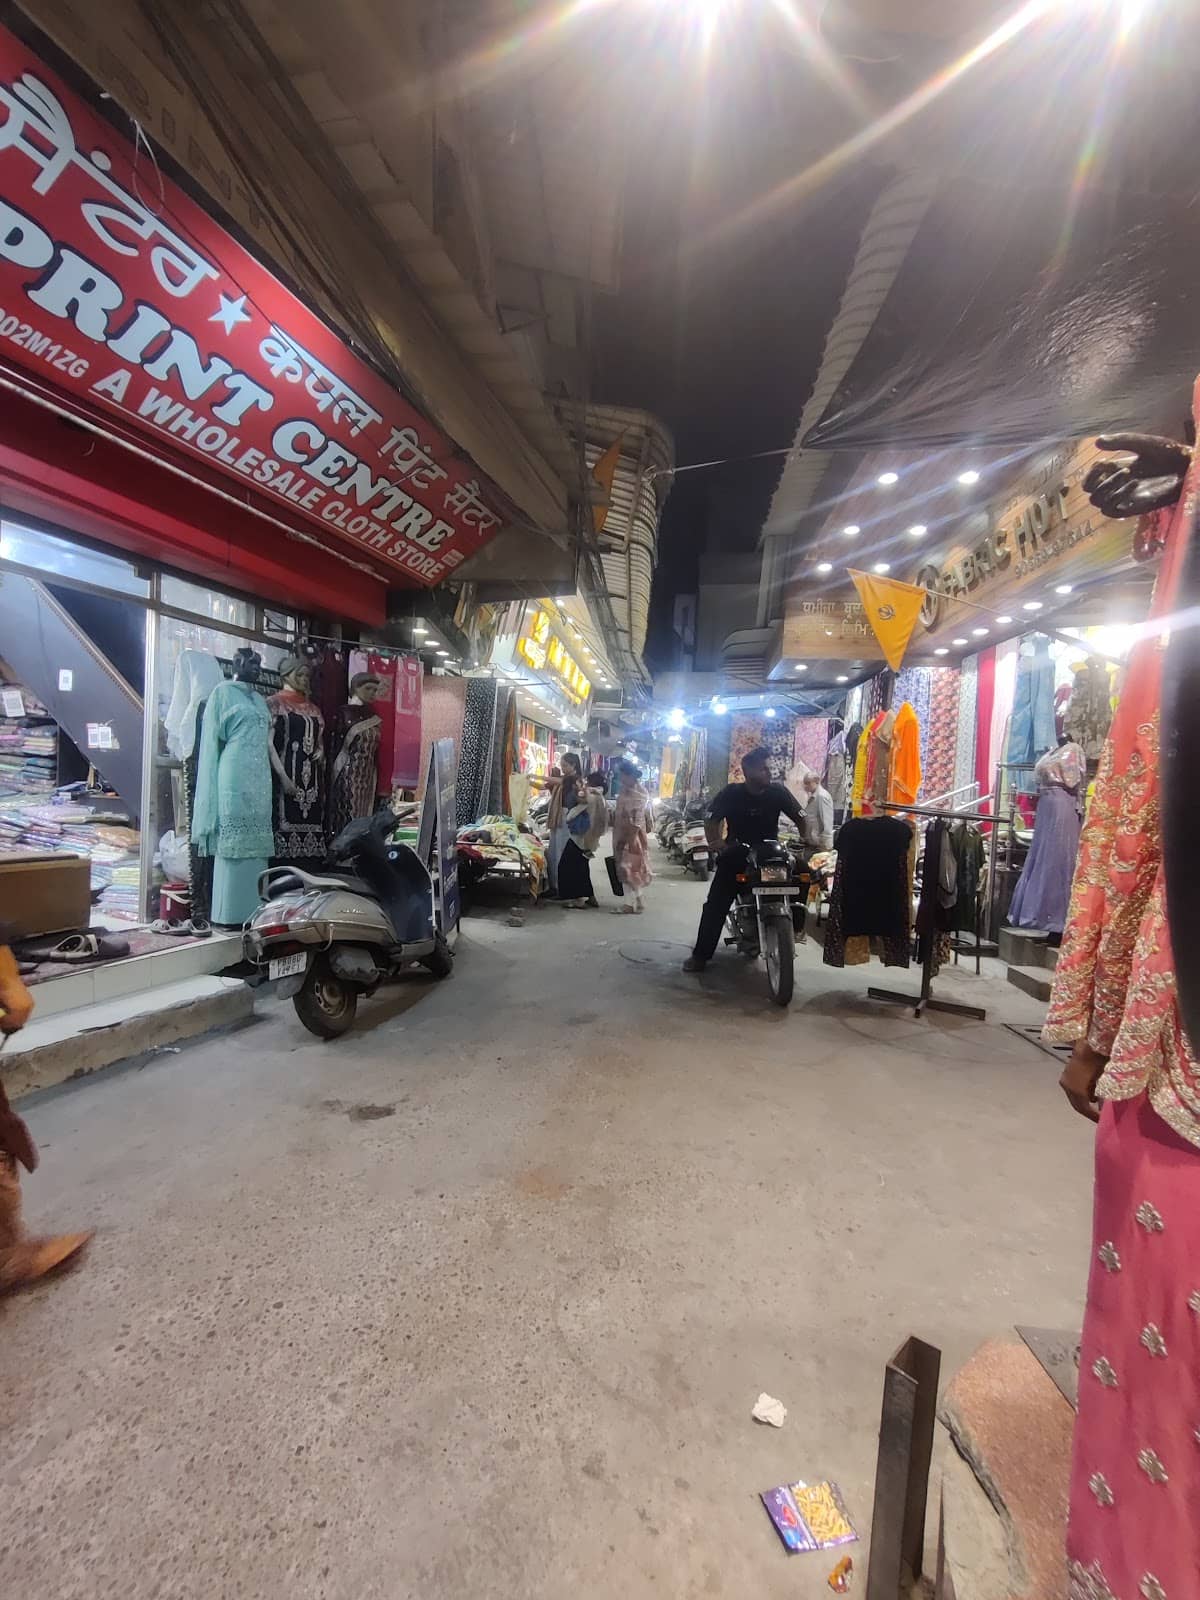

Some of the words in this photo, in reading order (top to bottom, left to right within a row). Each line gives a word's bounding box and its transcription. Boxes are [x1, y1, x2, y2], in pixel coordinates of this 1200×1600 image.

[0, 204, 274, 426] PRINT
[271, 419, 455, 552] CENTRE
[0, 307, 90, 379] 02M1ZG
[92, 368, 132, 403] A
[137, 387, 327, 510] WHOLESALE
[321, 500, 394, 548] CLOTH
[387, 540, 445, 579] STORE
[259, 322, 383, 437] कपल
[941, 527, 1012, 598] FABRIC
[1012, 478, 1070, 558] HUT
